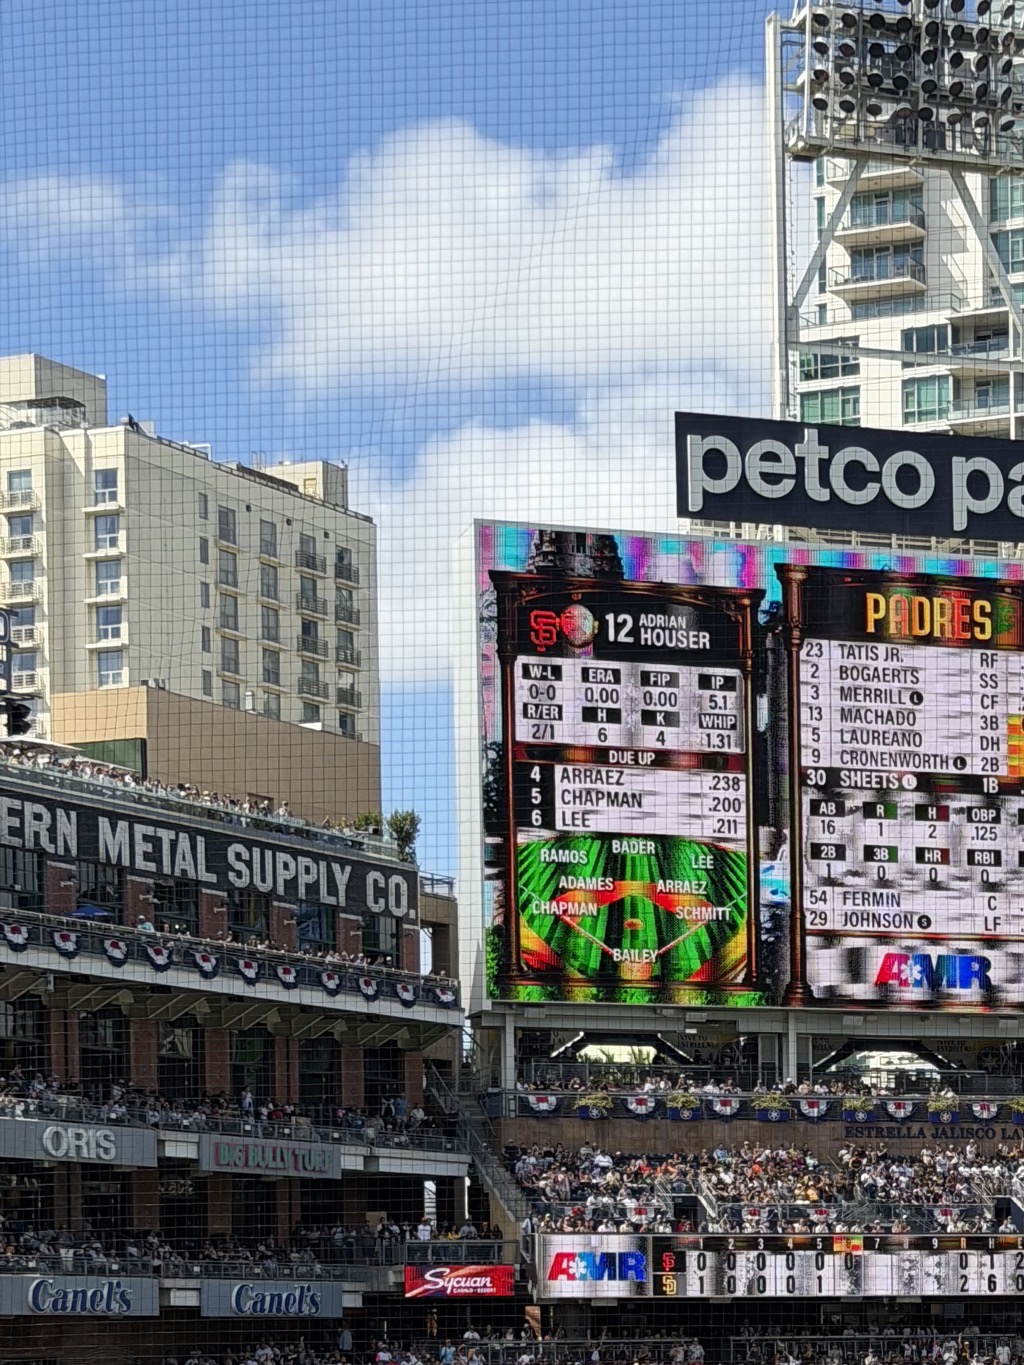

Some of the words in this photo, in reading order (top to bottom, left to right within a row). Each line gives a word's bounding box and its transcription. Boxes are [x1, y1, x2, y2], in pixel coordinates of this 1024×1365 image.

[687, 428, 935, 512] petco
[866, 592, 993, 641] PADRES
[605, 613, 634, 643] 12
[639, 613, 687, 629] ADRIAN
[640, 630, 711, 649] HOUSER
[805, 643, 824, 658] 23
[838, 644, 879, 662] TATIS
[884, 647, 904, 664] JR.
[980, 653, 999, 669] RF
[529, 665, 556, 680] W-L
[588, 669, 615, 684] ERA
[650, 673, 671, 686] FIP
[711, 677, 725, 690] IP
[839, 665, 920, 685] BOGAERTS
[585, 687, 619, 704] 0.00
[643, 691, 678, 708] 0.00
[708, 695, 728, 711] 5.1
[840, 686, 907, 705] MERRILL
[527, 705, 559, 720] R/ER
[701, 714, 736, 729] WHIP
[808, 706, 823, 722] 13
[840, 708, 917, 727] MACHADO
[705, 733, 732, 750] 1.31
[840, 728, 923, 748] LAUREANO
[980, 737, 1000, 752] DH
[609, 750, 635, 765] DUE
[640, 752, 656, 766] UP
[840, 750, 949, 770] CRONENWORTH
[560, 767, 625, 787] ARRAEZ
[708, 775, 741, 792] .238
[807, 769, 827, 786] 30
[840, 771, 899, 790] SHEETS
[982, 777, 999, 794] 1B
[561, 789, 643, 809] CHAPMAN
[708, 798, 741, 813] .200
[819, 801, 837, 815] AB
[972, 808, 997, 822] OBP
[562, 811, 591, 828] LEE
[712, 818, 738, 834] .211
[820, 820, 836, 835] 16
[971, 826, 998, 842] .125
[540, 849, 588, 864] RAMOS
[611, 840, 656, 855] BADER
[821, 846, 836, 859] 2B
[924, 849, 942, 863] HR
[975, 852, 995, 865] RBI
[99, 816, 217, 883] METAL
[227, 843, 352, 907] SUPPLY
[366, 871, 416, 919] CO.
[691, 855, 715, 869] LEE
[559, 876, 614, 891] ADAMES
[657, 879, 708, 895] ARRAEZ
[531, 901, 598, 916] CHAPMAN
[809, 890, 828, 905] 54
[842, 891, 901, 908] FERMIN
[675, 906, 732, 921] SCHMITT
[809, 911, 828, 926] 29
[842, 912, 914, 930] JOHNSON
[613, 949, 659, 964] BAILEY
[875, 952, 993, 990] AMR
[43, 1126, 116, 1160] ORIS
[844, 1126, 927, 1139] ESTRELLA
[931, 1127, 996, 1140] JALISCO
[547, 1252, 646, 1281] AMR
[424, 1268, 493, 1295] Sycuan
[28, 1279, 134, 1314] Canel's
[231, 1283, 322, 1316] Canel's
